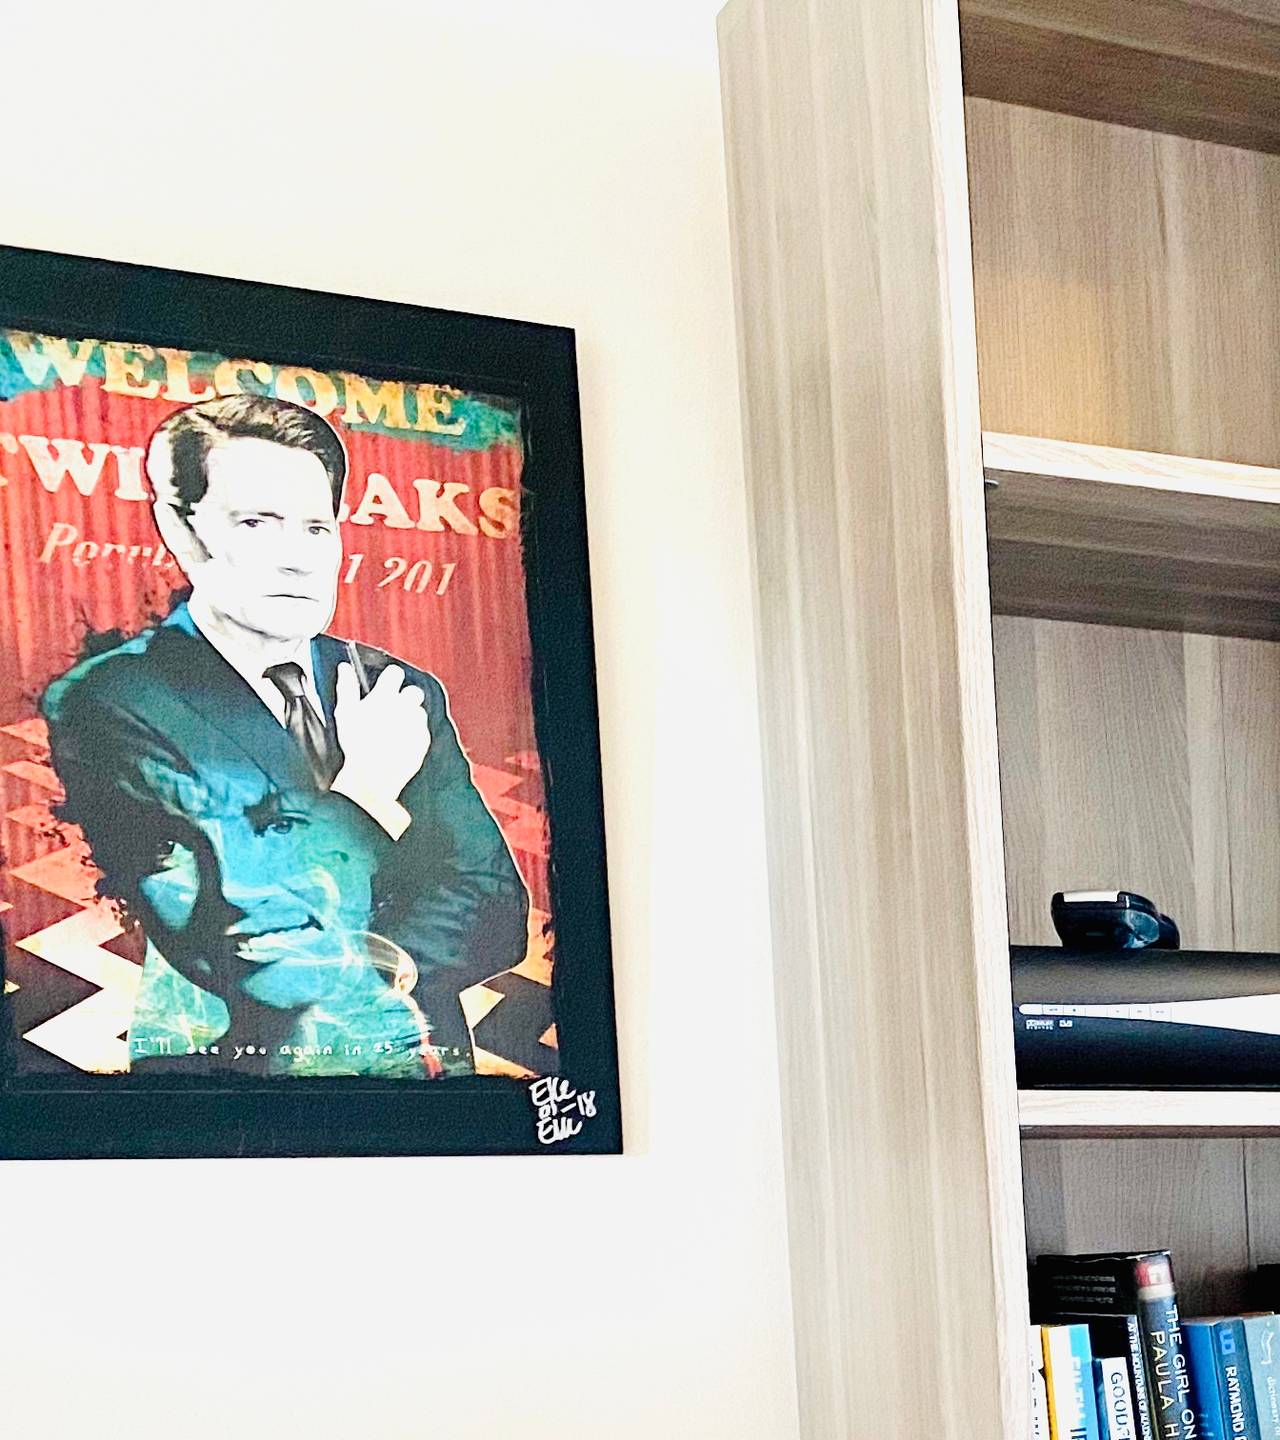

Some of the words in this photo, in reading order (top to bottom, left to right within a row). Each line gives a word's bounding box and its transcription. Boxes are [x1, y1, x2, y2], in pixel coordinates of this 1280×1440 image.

[6, 329, 467, 436] WELCOME
[339, 473, 517, 539] AKS
[186, 1044, 219, 1055] see
[233, 1044, 268, 1060] you
[279, 1044, 332, 1062] again
[345, 1042, 361, 1056] in
[1165, 1304, 1182, 1347] THE
[1151, 1331, 1175, 1410] PAULA
[1173, 1354, 1191, 1403] GIRL
[1181, 1409, 1197, 1440] ON
[1225, 1366, 1245, 1434] RAYMOND
